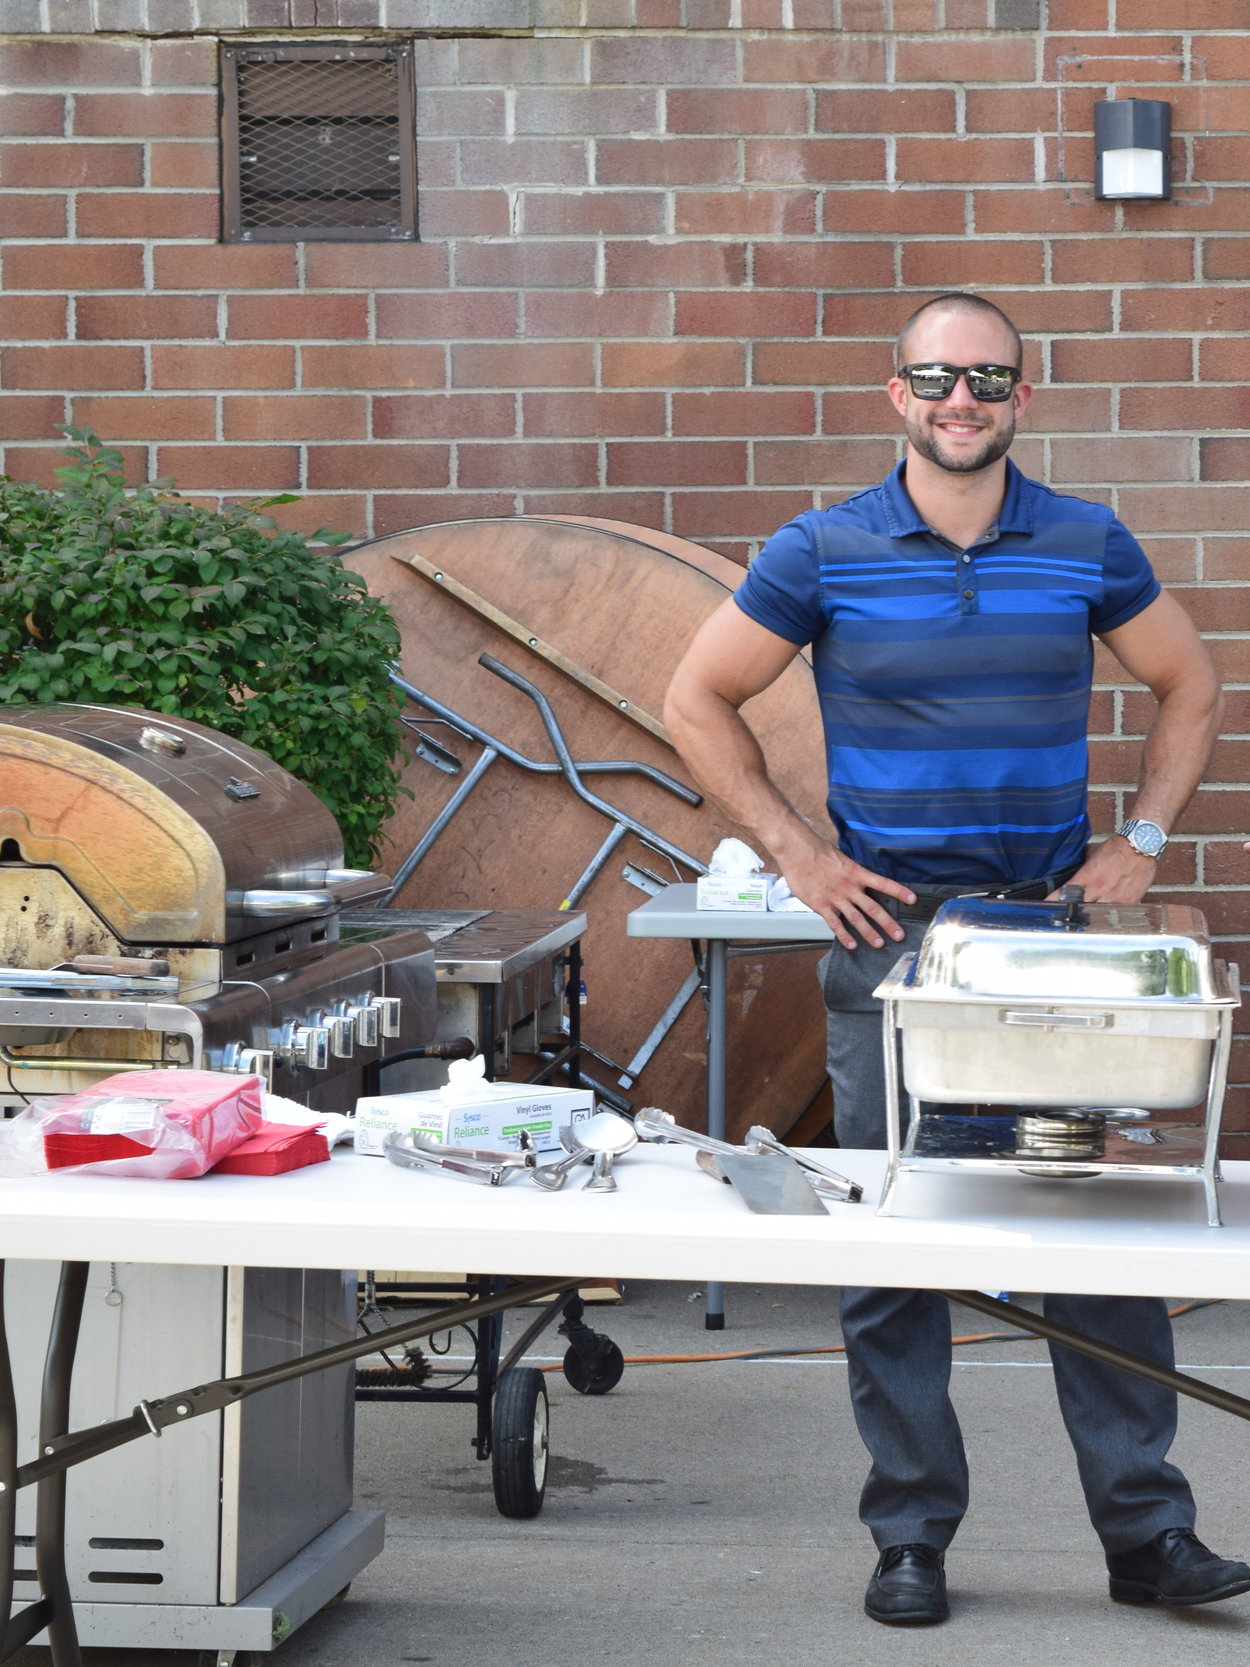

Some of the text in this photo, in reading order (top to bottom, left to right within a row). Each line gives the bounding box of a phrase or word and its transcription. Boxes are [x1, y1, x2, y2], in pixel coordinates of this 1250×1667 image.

[371, 1106, 390, 1116] Sysco
[516, 1103, 552, 1115] Vinyl Gloves
[418, 1111, 443, 1121] Guantes
[463, 1113, 481, 1123] Sysco
[359, 1116, 398, 1131] Reliance
[420, 1120, 428, 1128] de
[454, 1125, 490, 1139] Reliance
